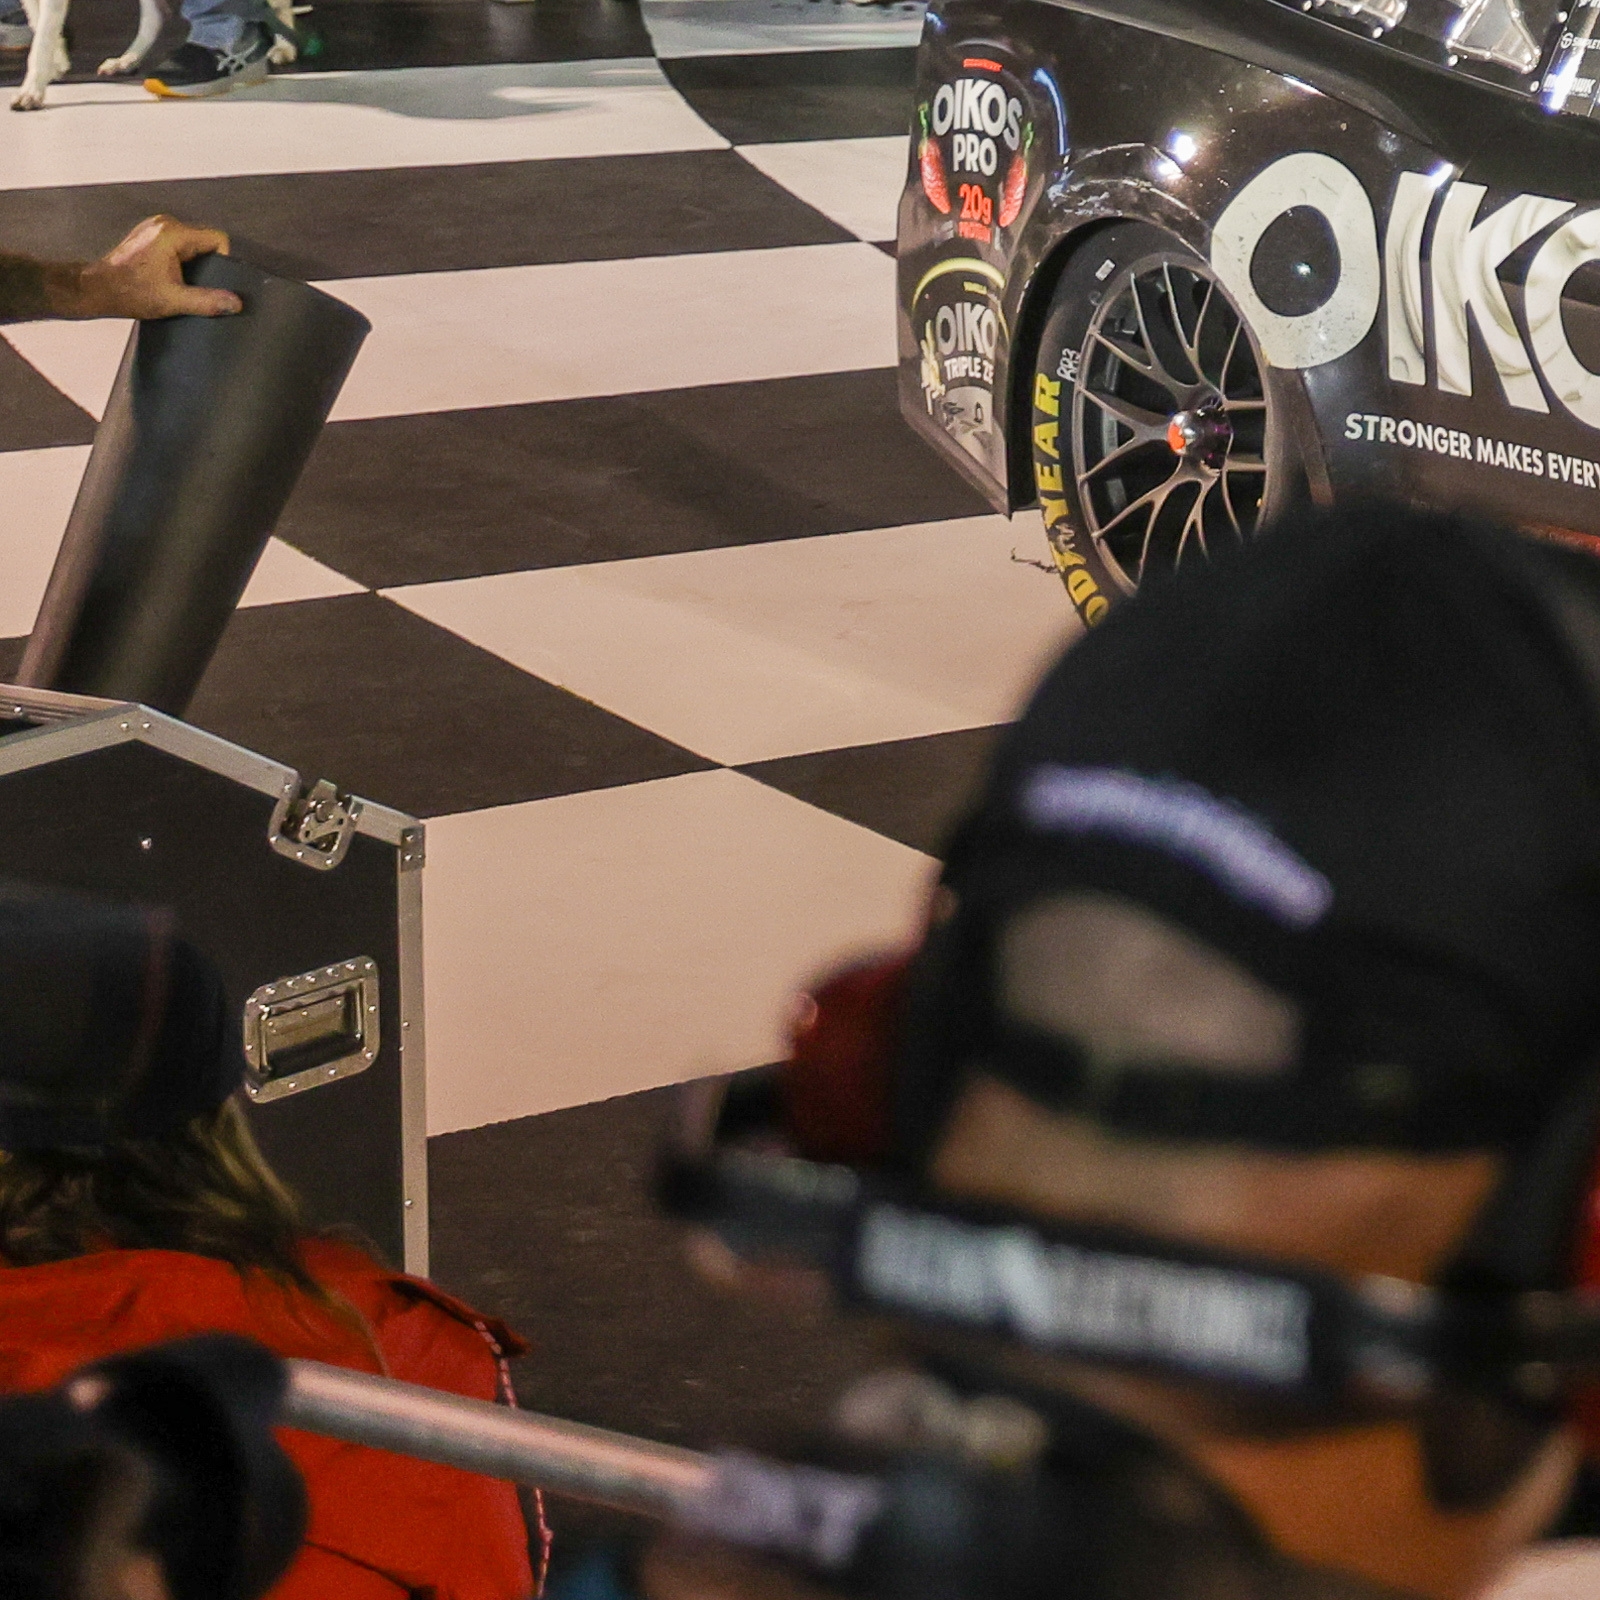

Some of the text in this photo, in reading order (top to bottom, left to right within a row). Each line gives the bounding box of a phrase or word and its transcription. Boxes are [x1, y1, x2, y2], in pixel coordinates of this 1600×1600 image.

[932, 78, 1023, 151] OIKOS
[953, 133, 998, 177] PRO
[958, 183, 994, 226] 20g
[935, 301, 998, 357] OIKO
[943, 357, 982, 380] TRIPLE
[1345, 413, 1474, 461] STRONGER
[1476, 438, 1545, 478] MAKES
